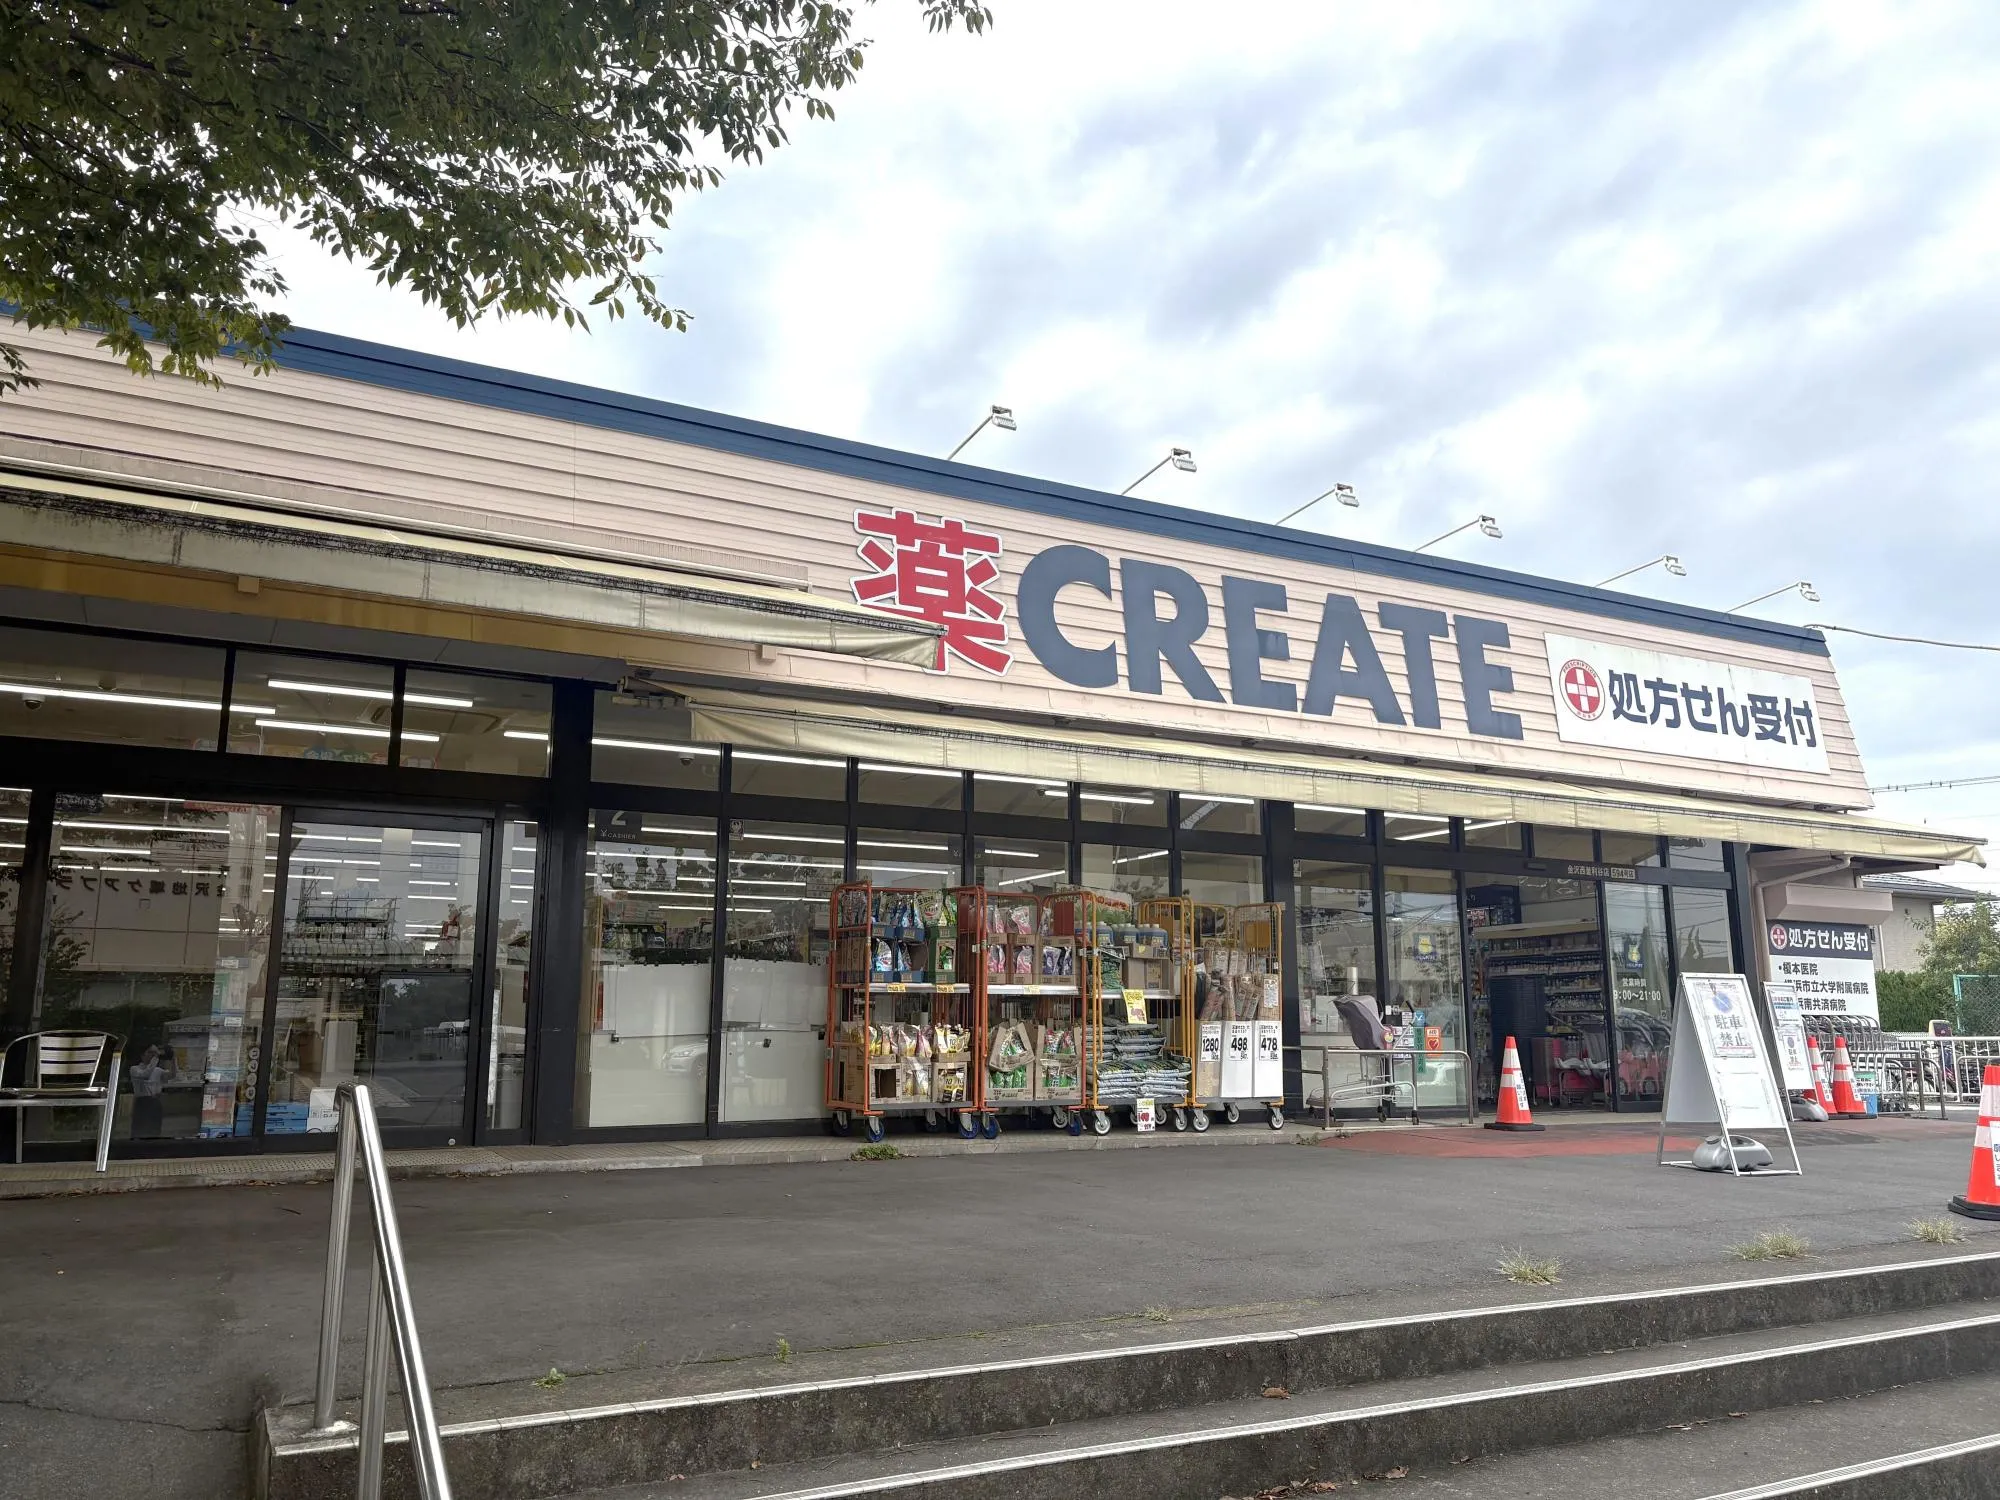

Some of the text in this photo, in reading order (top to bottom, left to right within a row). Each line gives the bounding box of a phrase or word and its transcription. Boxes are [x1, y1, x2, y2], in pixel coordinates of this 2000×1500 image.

[856, 510, 1524, 741] 薬 CREATE
[1608, 669, 1817, 748] 処方せん受付
[1788, 928, 1869, 952] 処方せん受付
[1784, 979, 1870, 995] 浜市立大学附属病院
[1714, 1014, 1744, 1030] 駐車
[1202, 1037, 1219, 1052] 1280
[1231, 1036, 1248, 1051] 498
[1261, 1037, 1278, 1051] 478
